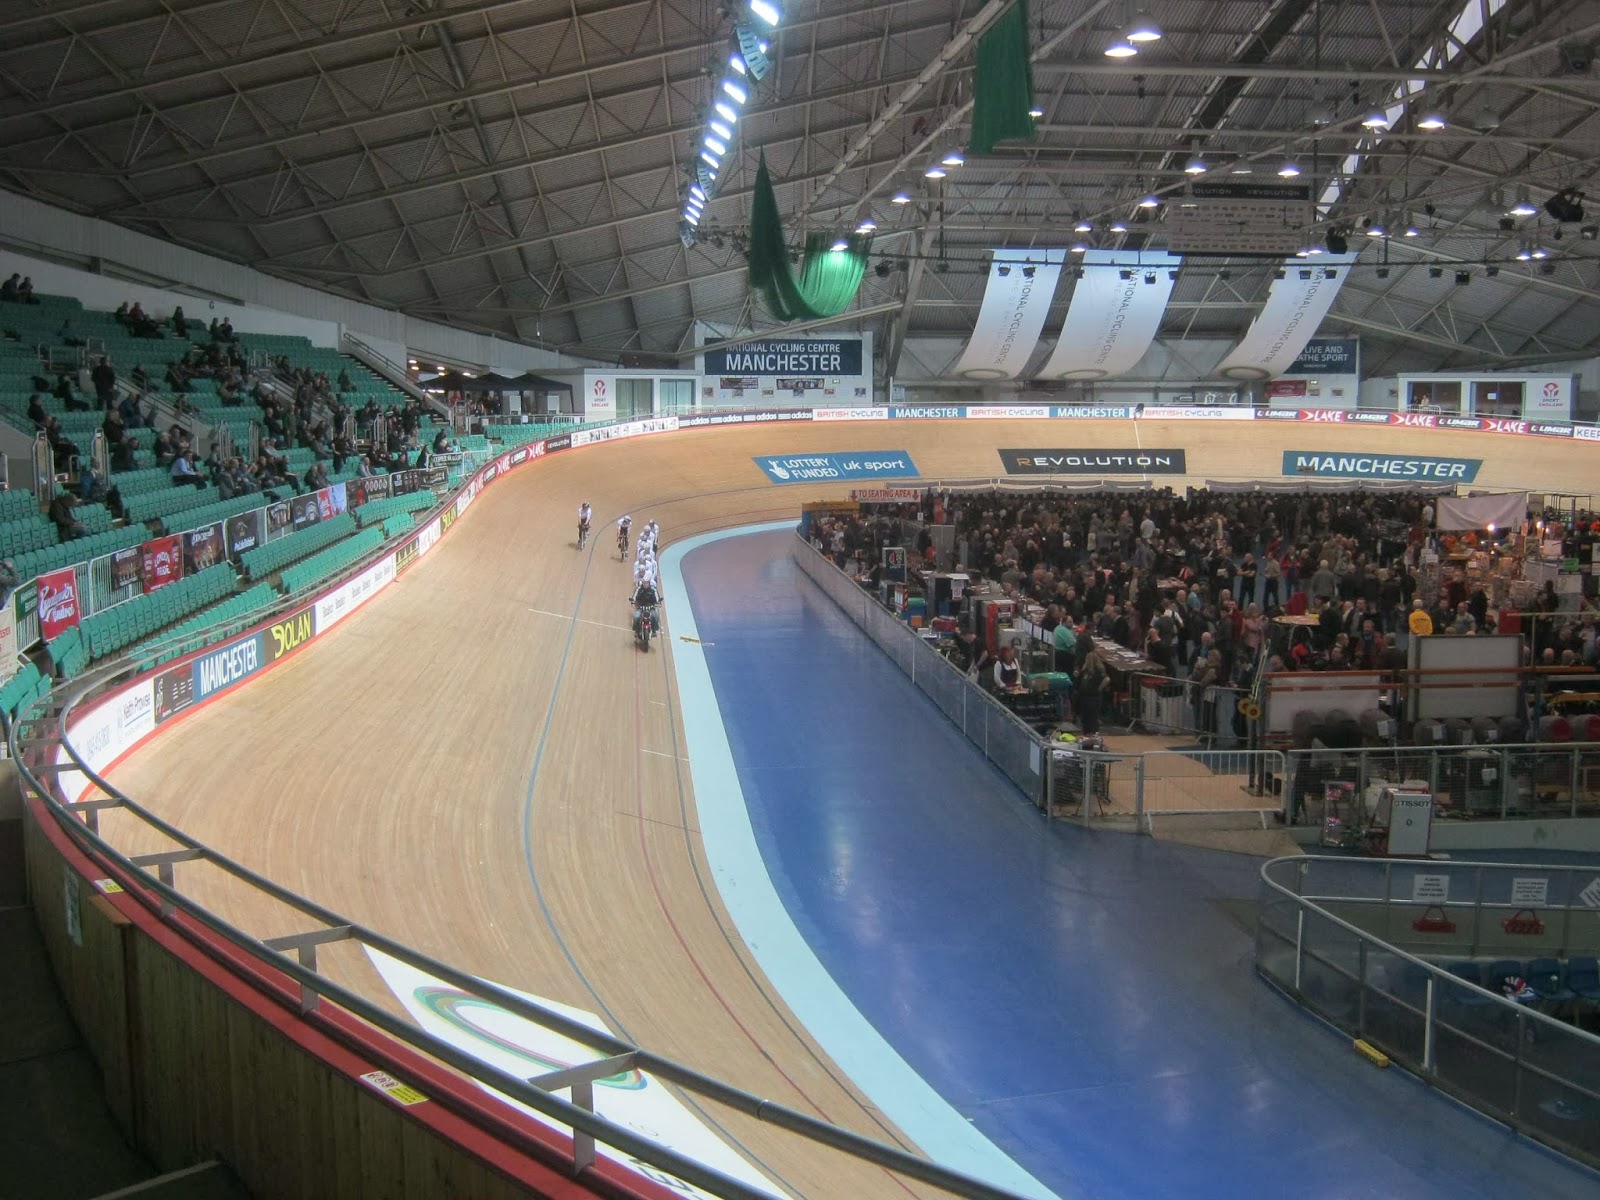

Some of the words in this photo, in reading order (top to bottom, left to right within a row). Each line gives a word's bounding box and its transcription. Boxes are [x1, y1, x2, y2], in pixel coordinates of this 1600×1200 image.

[1118, 268, 1141, 313] NATIONAL
[1298, 266, 1326, 311] NATIONAL
[1004, 312, 1024, 343] CYCLING
[1105, 314, 1126, 344] CYCLING
[1278, 311, 1304, 342] CYCLING
[726, 343, 768, 353] NATIONAL
[769, 343, 805, 353] CYCLING
[807, 343, 841, 353] CENTRE
[1259, 341, 1285, 364] CENTRE
[1304, 346, 1322, 354] LIVE
[1324, 346, 1343, 354] AND
[993, 343, 1012, 366] CENTRE
[1093, 344, 1113, 366] CENTRE
[1323, 354, 1349, 362] SPORT
[725, 354, 841, 371] MANCHESTER
[722, 414, 743, 423] adidas
[756, 412, 777, 421] adidas
[791, 410, 813, 419] adidas
[850, 410, 884, 418] CYCLING
[895, 407, 959, 418] MANCHESTER
[1057, 408, 1125, 418] MANCHESTER
[1145, 409, 1182, 417] BRITISH
[1183, 409, 1223, 417] CYCLING
[1313, 410, 1343, 422] LAKE
[690, 416, 710, 425] adidas
[1404, 414, 1435, 427] LAKE
[1496, 421, 1526, 433] LAKE
[547, 440, 570, 449] REVOLUTION
[785, 458, 829, 469] LOTTERY
[843, 460, 863, 470] uk
[864, 459, 905, 472] sport
[1016, 456, 1171, 468] REVOLUTION
[1296, 456, 1467, 477] MANCHESTER
[791, 467, 839, 478] FUNDED
[858, 489, 867, 498] TO
[868, 489, 893, 498] SEATING
[894, 489, 912, 498] AREA
[271, 611, 311, 660] DOLAN
[200, 638, 258, 697] MANCHESTER
[1400, 800, 1430, 808] TISSOT
